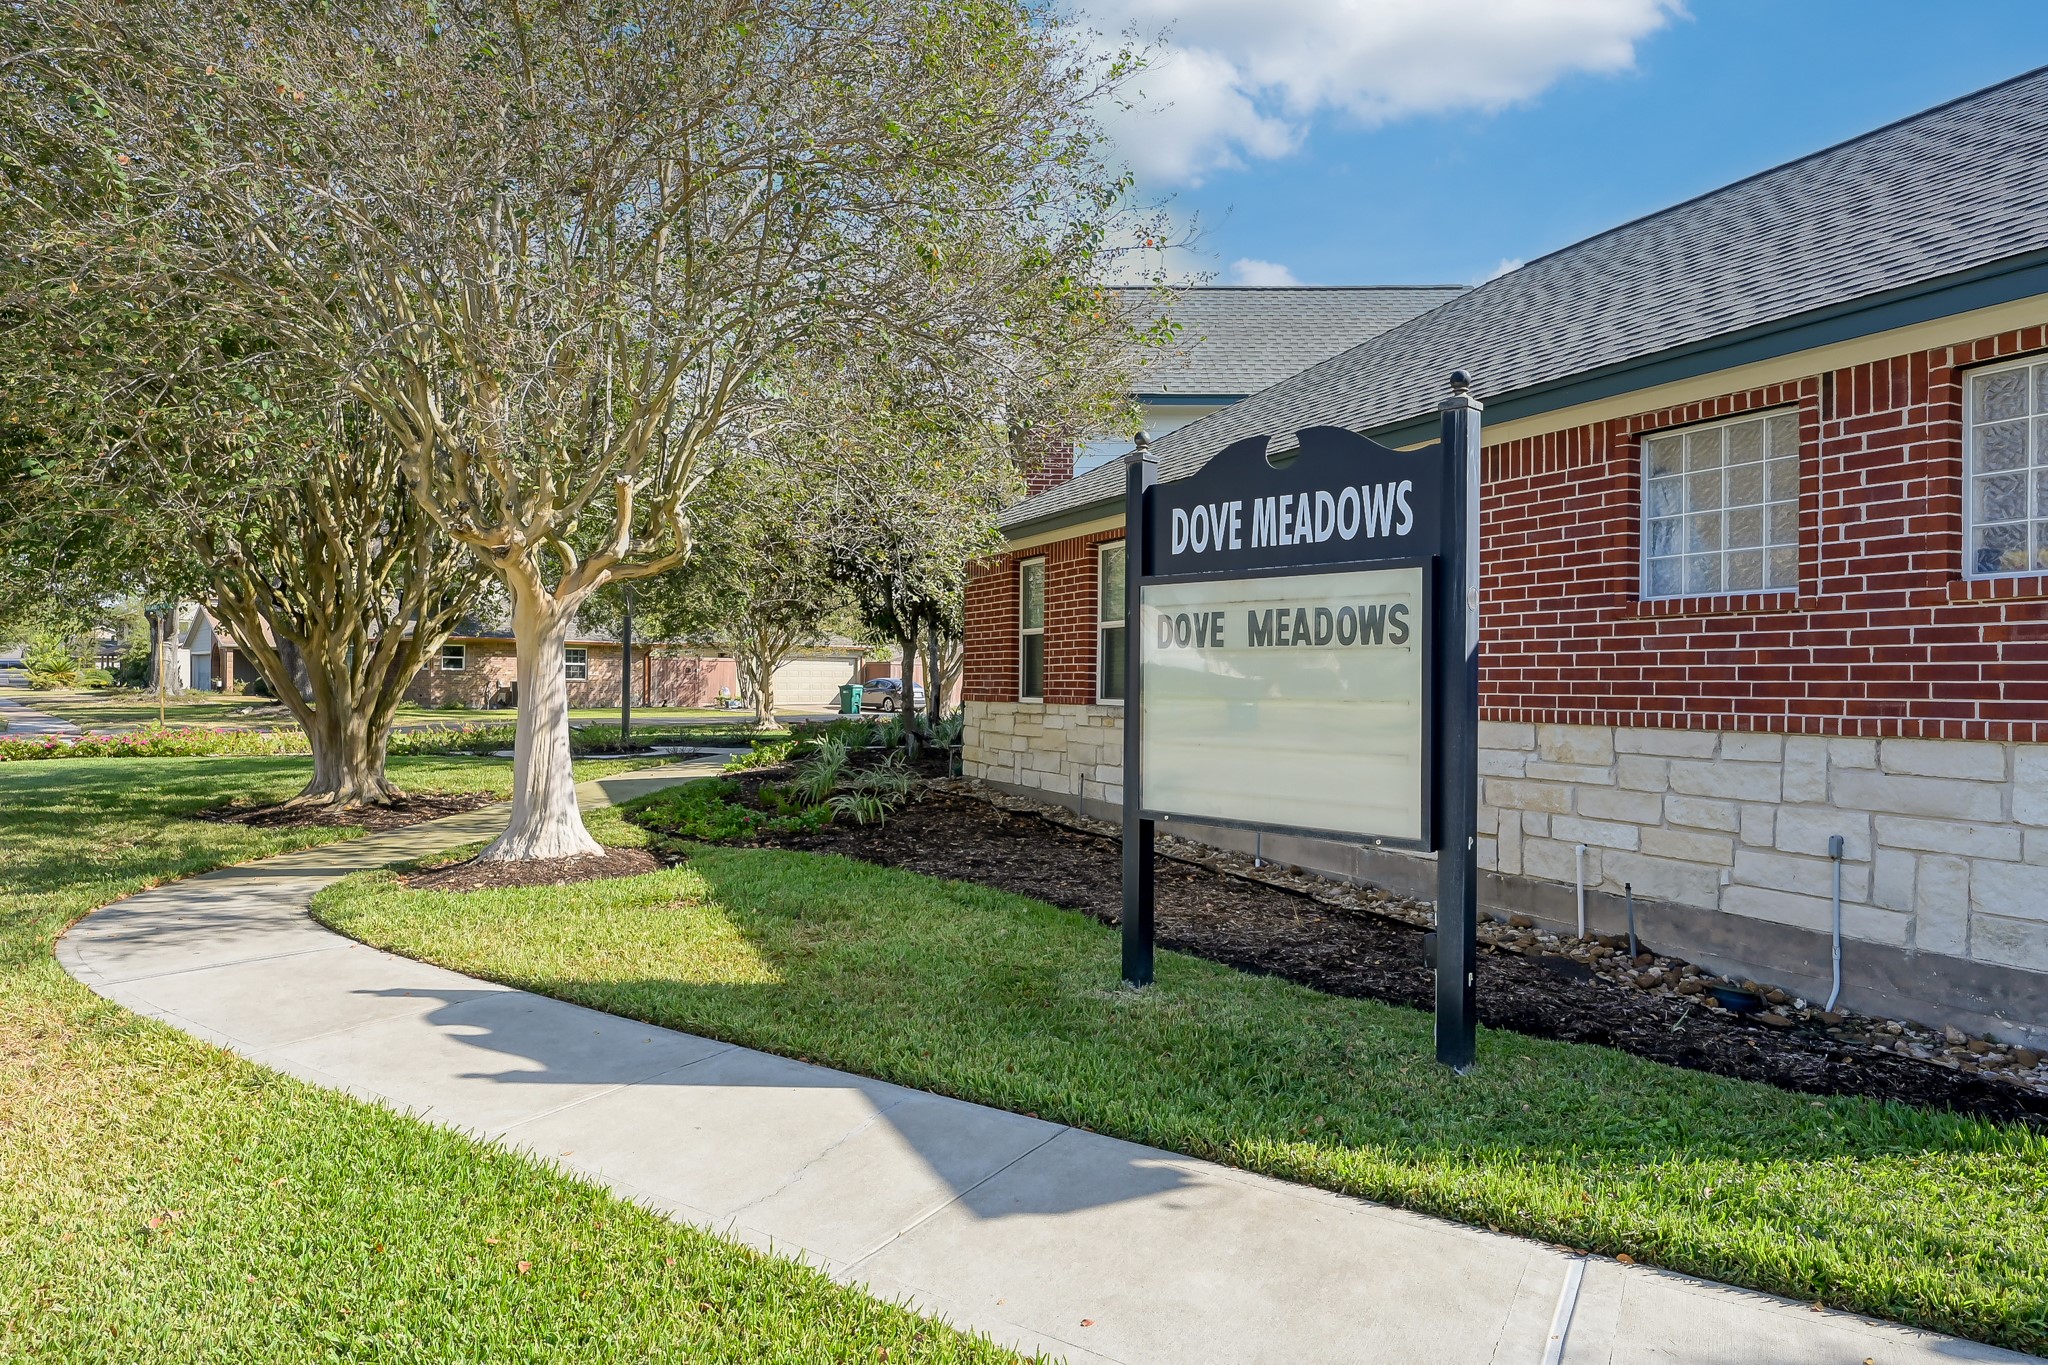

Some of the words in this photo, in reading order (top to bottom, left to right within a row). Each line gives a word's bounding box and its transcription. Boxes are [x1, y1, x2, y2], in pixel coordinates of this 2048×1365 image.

[1172, 501, 1241, 555] DOVE
[1251, 480, 1413, 547] MEADOWS
[1158, 612, 1224, 648] DOVE
[1248, 603, 1410, 647] MEADOWS
